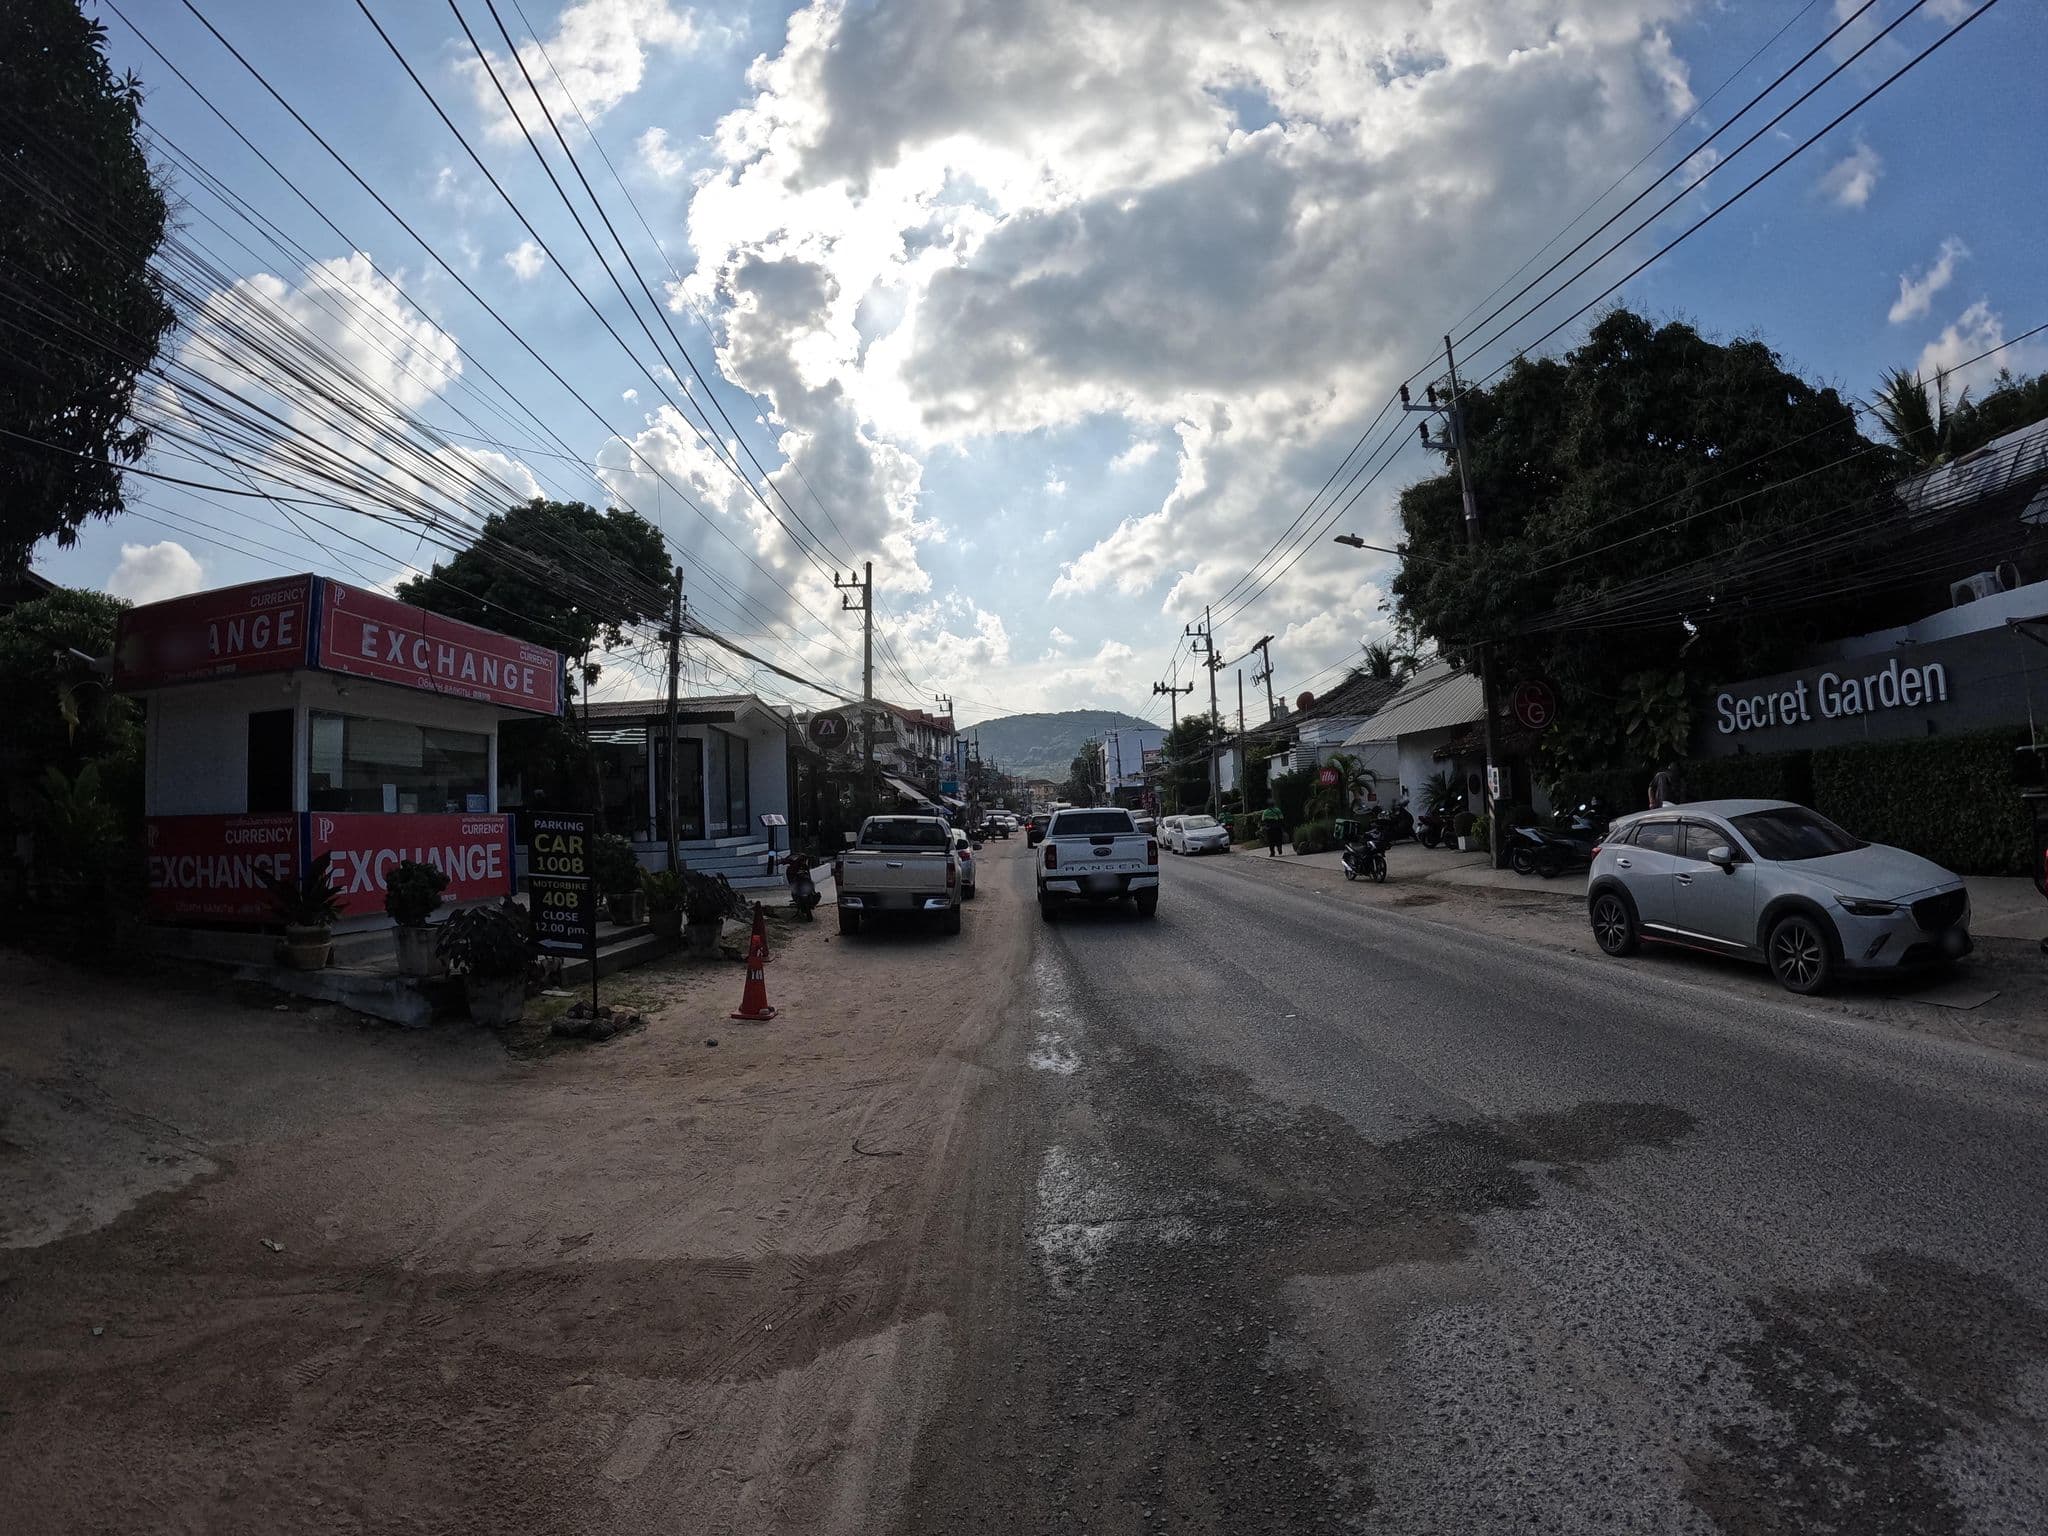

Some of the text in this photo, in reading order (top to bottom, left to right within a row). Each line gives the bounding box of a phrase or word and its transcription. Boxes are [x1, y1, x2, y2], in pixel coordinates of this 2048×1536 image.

[250, 587, 306, 608] CURRENCY
[361, 623, 535, 695] EXCHANGE
[519, 650, 553, 667] CURRENCY
[1716, 658, 1948, 734] Secret Garden
[461, 822, 504, 835] CURRENCY
[534, 819, 585, 832] PARKING
[224, 826, 293, 844] CURRENCY
[534, 833, 584, 855] CAR
[1065, 863, 1141, 872] RANGER
[533, 879, 589, 891] MOTORBIKE
[542, 910, 579, 922] CLOSE
